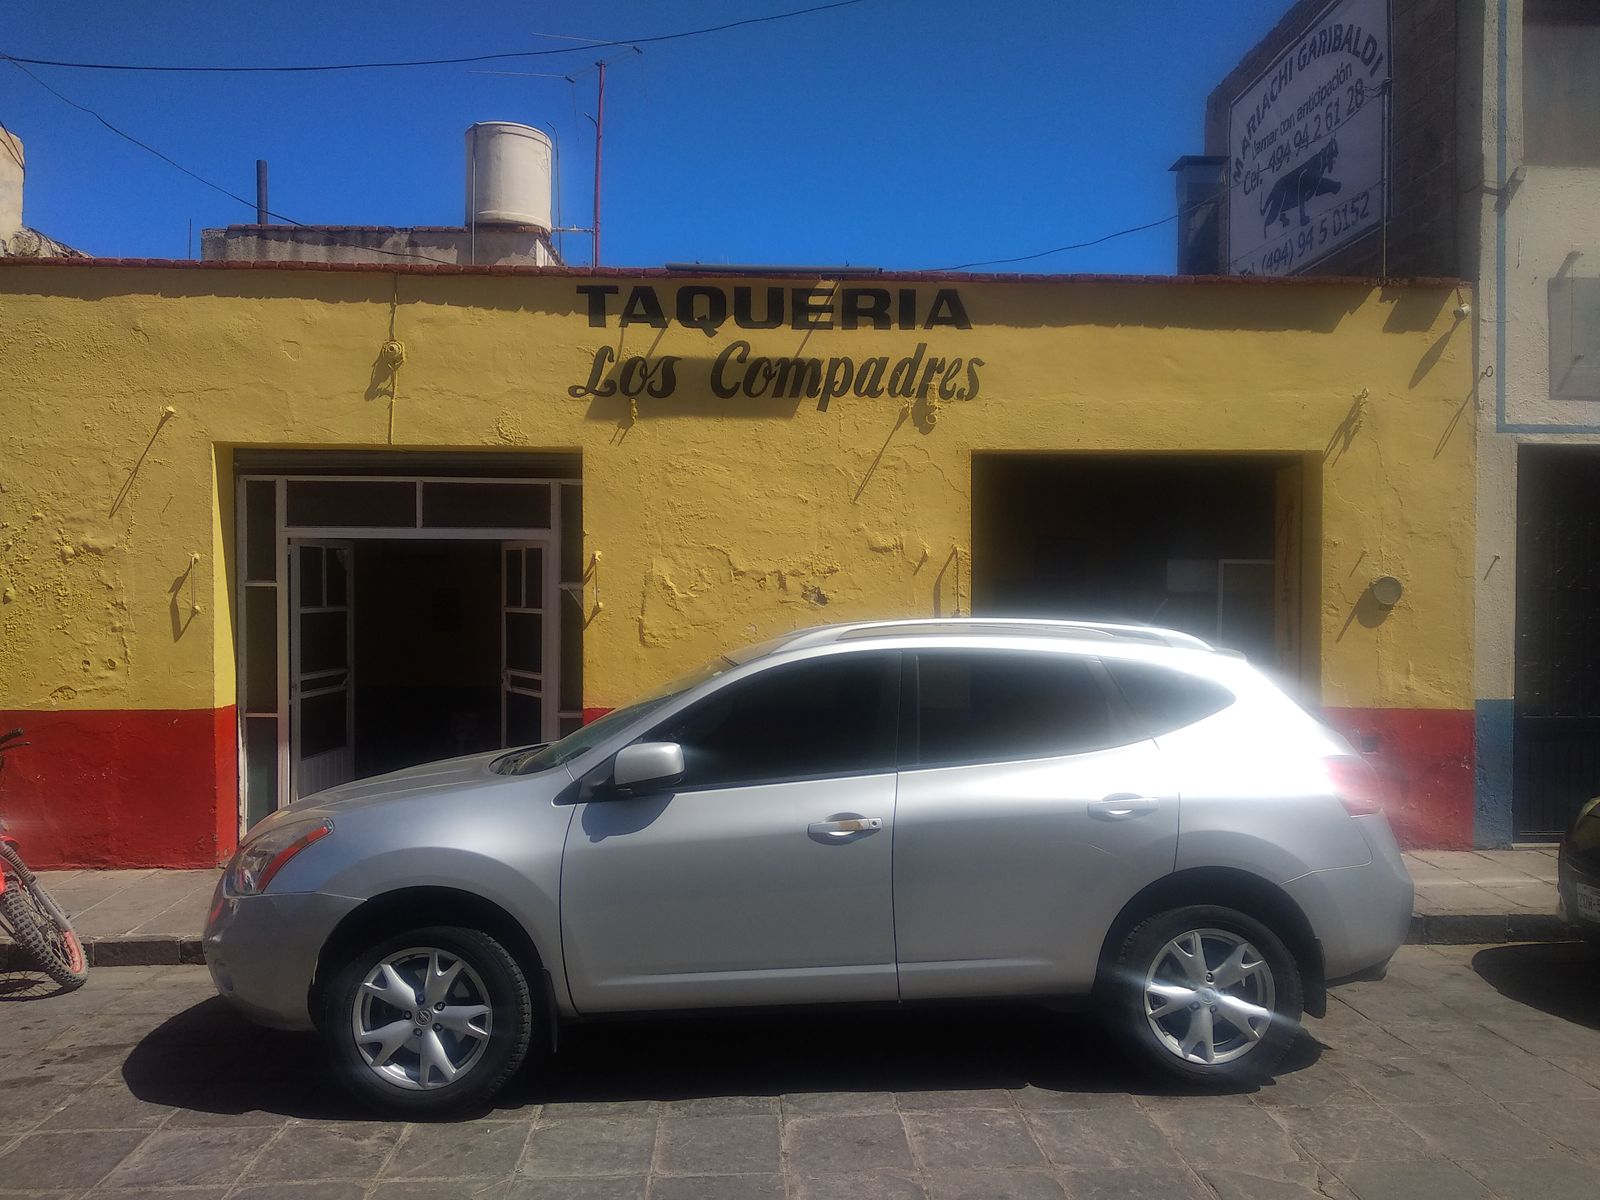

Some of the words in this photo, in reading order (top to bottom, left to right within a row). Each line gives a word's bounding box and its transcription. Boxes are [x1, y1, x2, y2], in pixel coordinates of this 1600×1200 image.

[1233, 56, 1293, 184] MARIACHI
[1297, 23, 1384, 78] GARIBALDI
[1268, 139, 1292, 174] 494
[1313, 113, 1322, 140] 2
[1325, 96, 1341, 131] 61
[1347, 78, 1365, 116] 28
[1280, 112, 1296, 136] con
[1297, 223, 1313, 259] 94
[576, 285, 973, 337] TAQUERIA
[567, 345, 682, 399] Los
[710, 340, 986, 412] Compadres
